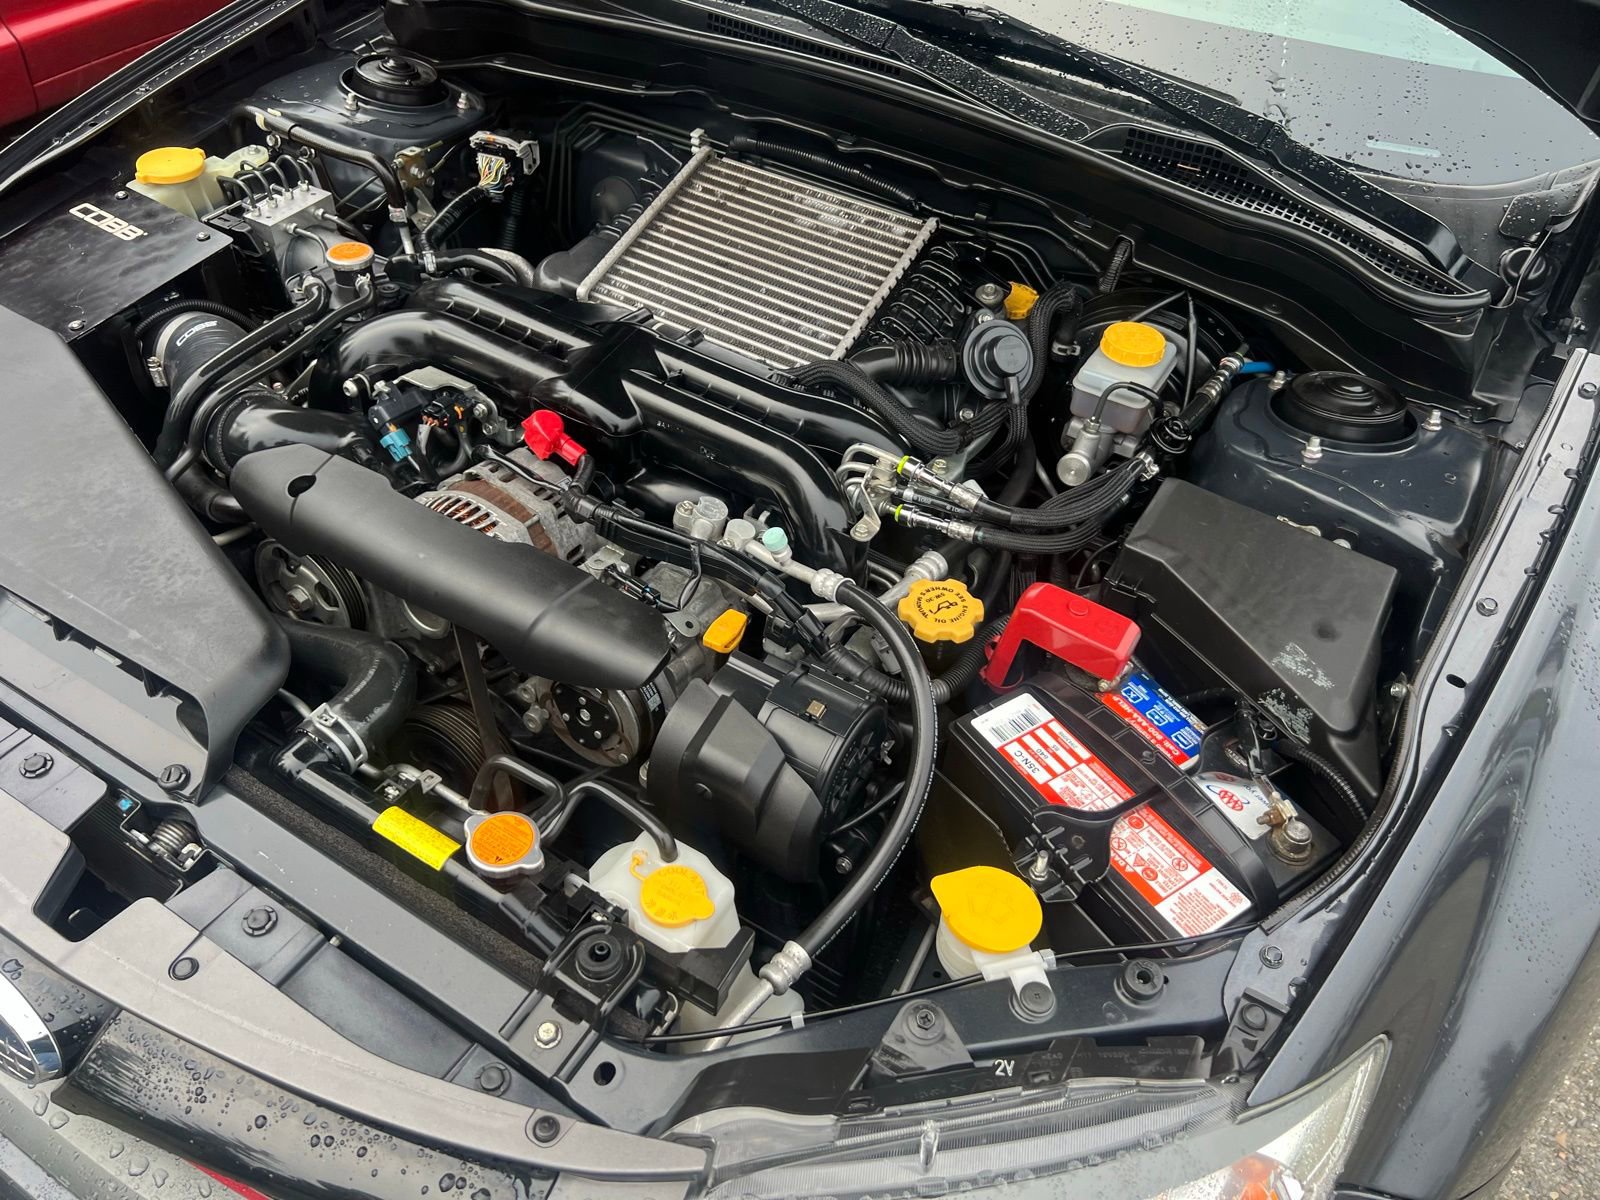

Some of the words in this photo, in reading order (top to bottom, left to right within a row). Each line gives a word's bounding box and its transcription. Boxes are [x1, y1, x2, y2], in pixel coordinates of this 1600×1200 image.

[69, 203, 143, 241] COBB
[176, 320, 218, 347] COBB
[925, 591, 945, 603] 5W-30
[949, 605, 968, 623] ENGINE
[1111, 693, 1164, 741] 800-AAA-HELP
[1162, 738, 1181, 756] Call:
[1012, 748, 1041, 775] 35N-C
[1218, 788, 1244, 812] AAA
[994, 1058, 1015, 1077] 2V
